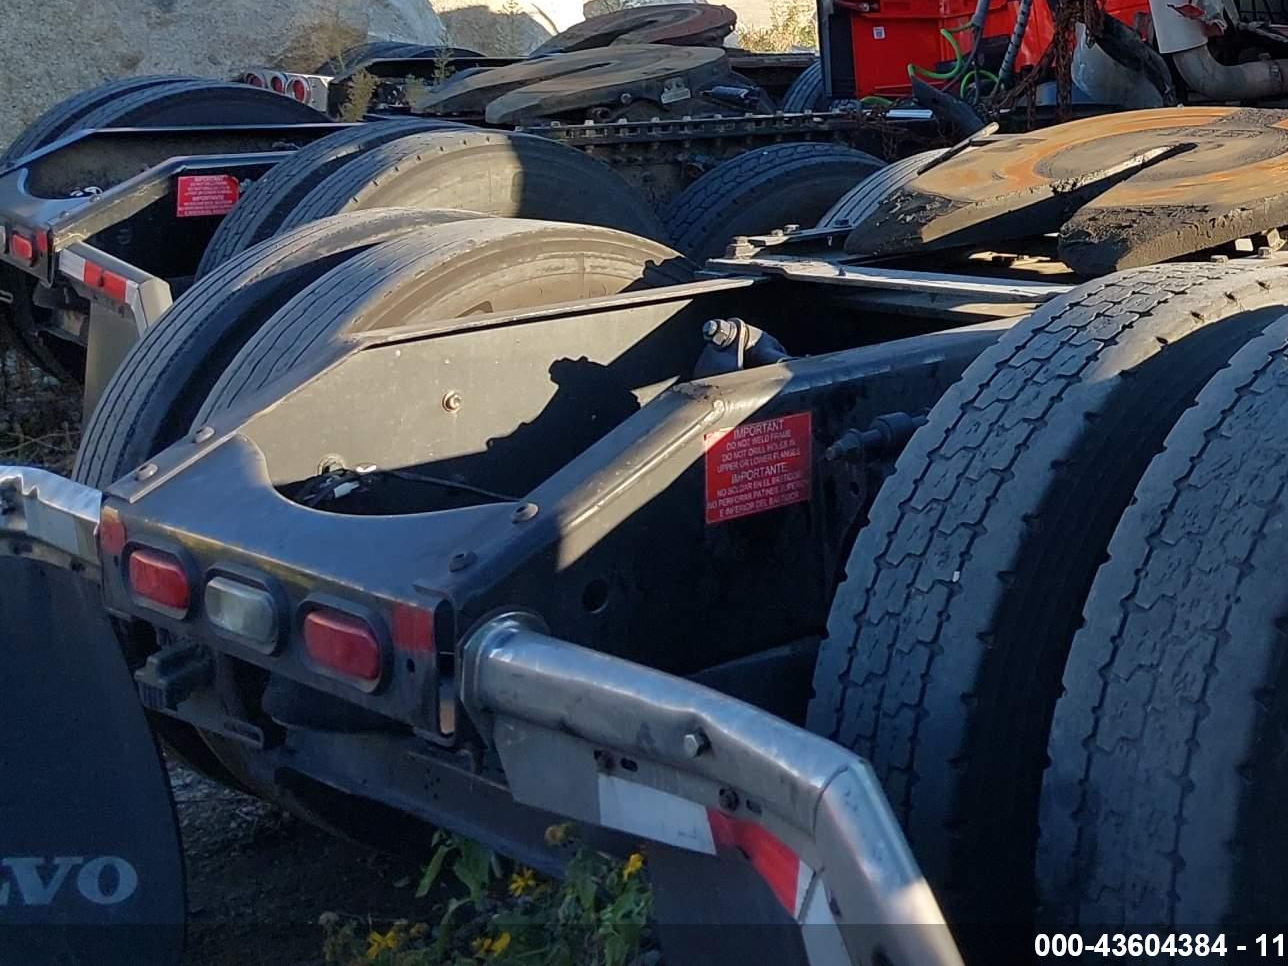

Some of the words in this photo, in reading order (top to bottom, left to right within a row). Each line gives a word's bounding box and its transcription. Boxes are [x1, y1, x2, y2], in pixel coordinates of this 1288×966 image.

[734, 419, 784, 439] IMPORTANT
[726, 442, 736, 451] DO
[738, 438, 750, 448] NOT
[752, 434, 769, 445] WELD
[716, 462, 738, 474] UPPER
[740, 460, 750, 468] OR
[750, 454, 772, 466] LOWER
[773, 447, 801, 460] FLANGES
[722, 452, 732, 462] DO
[734, 450, 746, 460] NOT
[748, 446, 766, 456] DRILL
[732, 462, 789, 484] IMPORTANTE
[717, 488, 727, 497] NO
[754, 480, 762, 489] EN
[763, 478, 770, 486] EL
[756, 498, 768, 508] DEL
